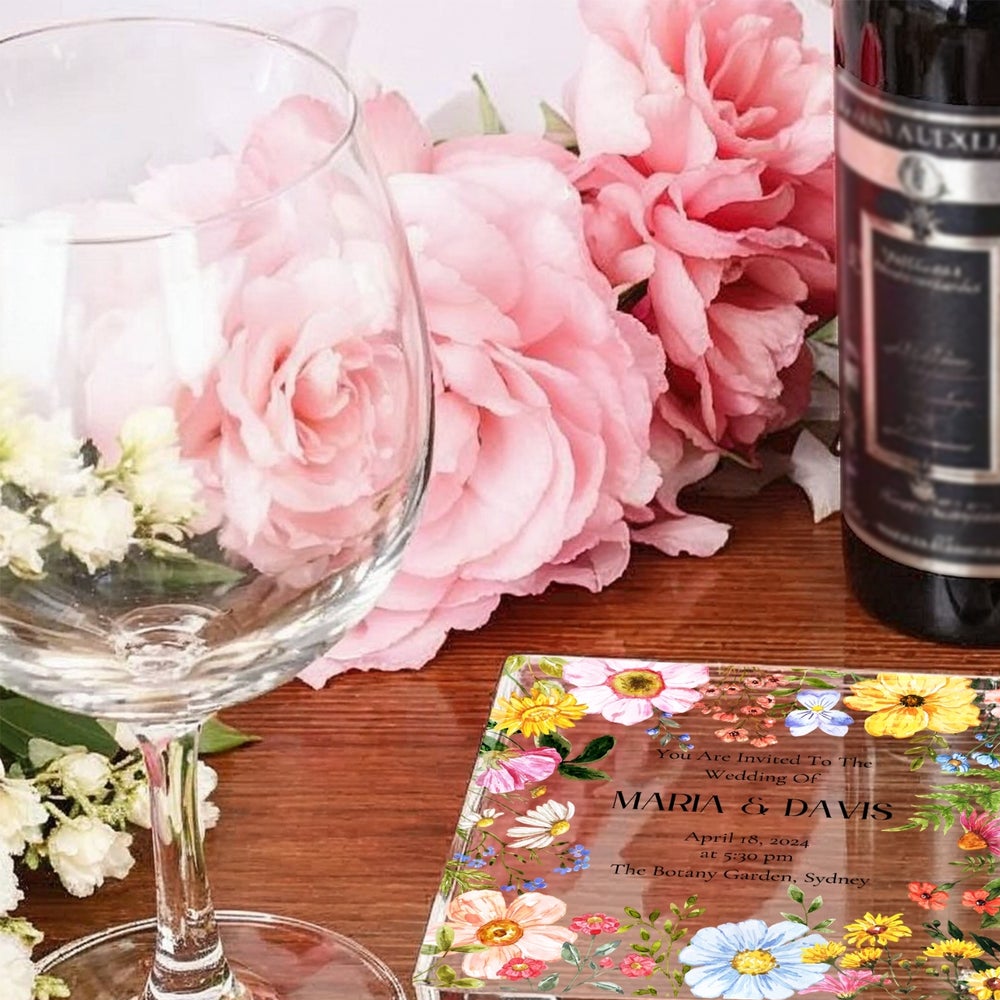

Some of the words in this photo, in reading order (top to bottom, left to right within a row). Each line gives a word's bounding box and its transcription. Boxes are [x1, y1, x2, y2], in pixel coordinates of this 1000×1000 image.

[656, 748, 691, 761] You
[697, 751, 731, 762] Are
[737, 752, 801, 766] Invited
[808, 755, 832, 767] To
[839, 756, 873, 769] The
[705, 769, 787, 785] Wedding
[793, 773, 821, 784] Of
[612, 790, 724, 813] MARIA
[741, 796, 769, 816] &
[784, 798, 894, 821] DAVIS
[684, 831, 734, 845] April
[741, 832, 763, 846] 18,
[769, 837, 809, 848] 2024
[700, 850, 717, 859] at
[723, 852, 757, 863] 5:30
[764, 853, 793, 865] pm
[610, 863, 646, 876] The
[653, 866, 717, 882] Botany
[723, 869, 797, 883] Garden,
[804, 872, 870, 888] Sydney
